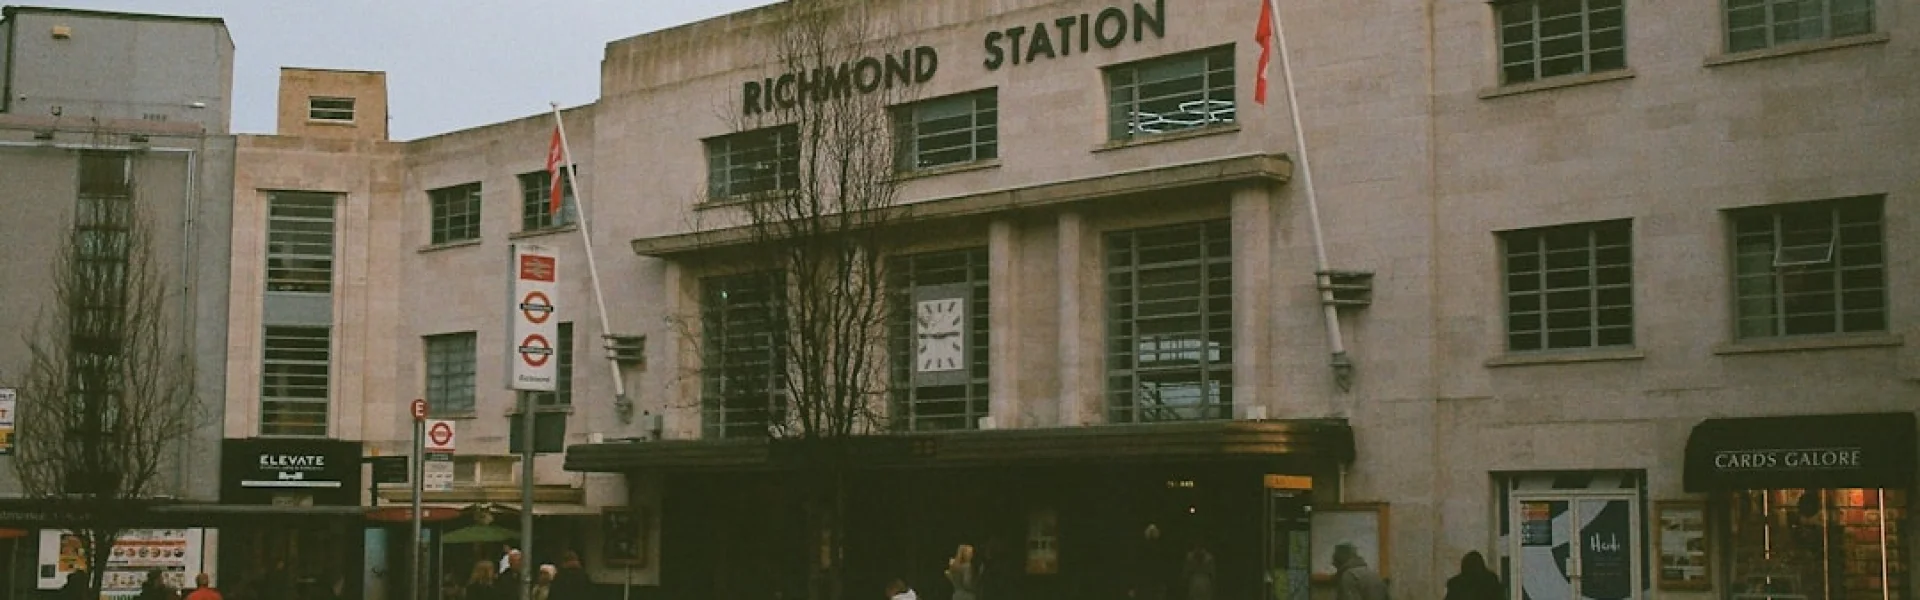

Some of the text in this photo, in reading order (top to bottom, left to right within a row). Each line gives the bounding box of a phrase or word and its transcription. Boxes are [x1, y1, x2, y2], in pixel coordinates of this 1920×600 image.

[743, 0, 1165, 116] RICHMOND STATION
[416, 402, 424, 416] E
[260, 455, 325, 466] ELEVATE
[1715, 450, 1860, 468] CARDS GALORE
